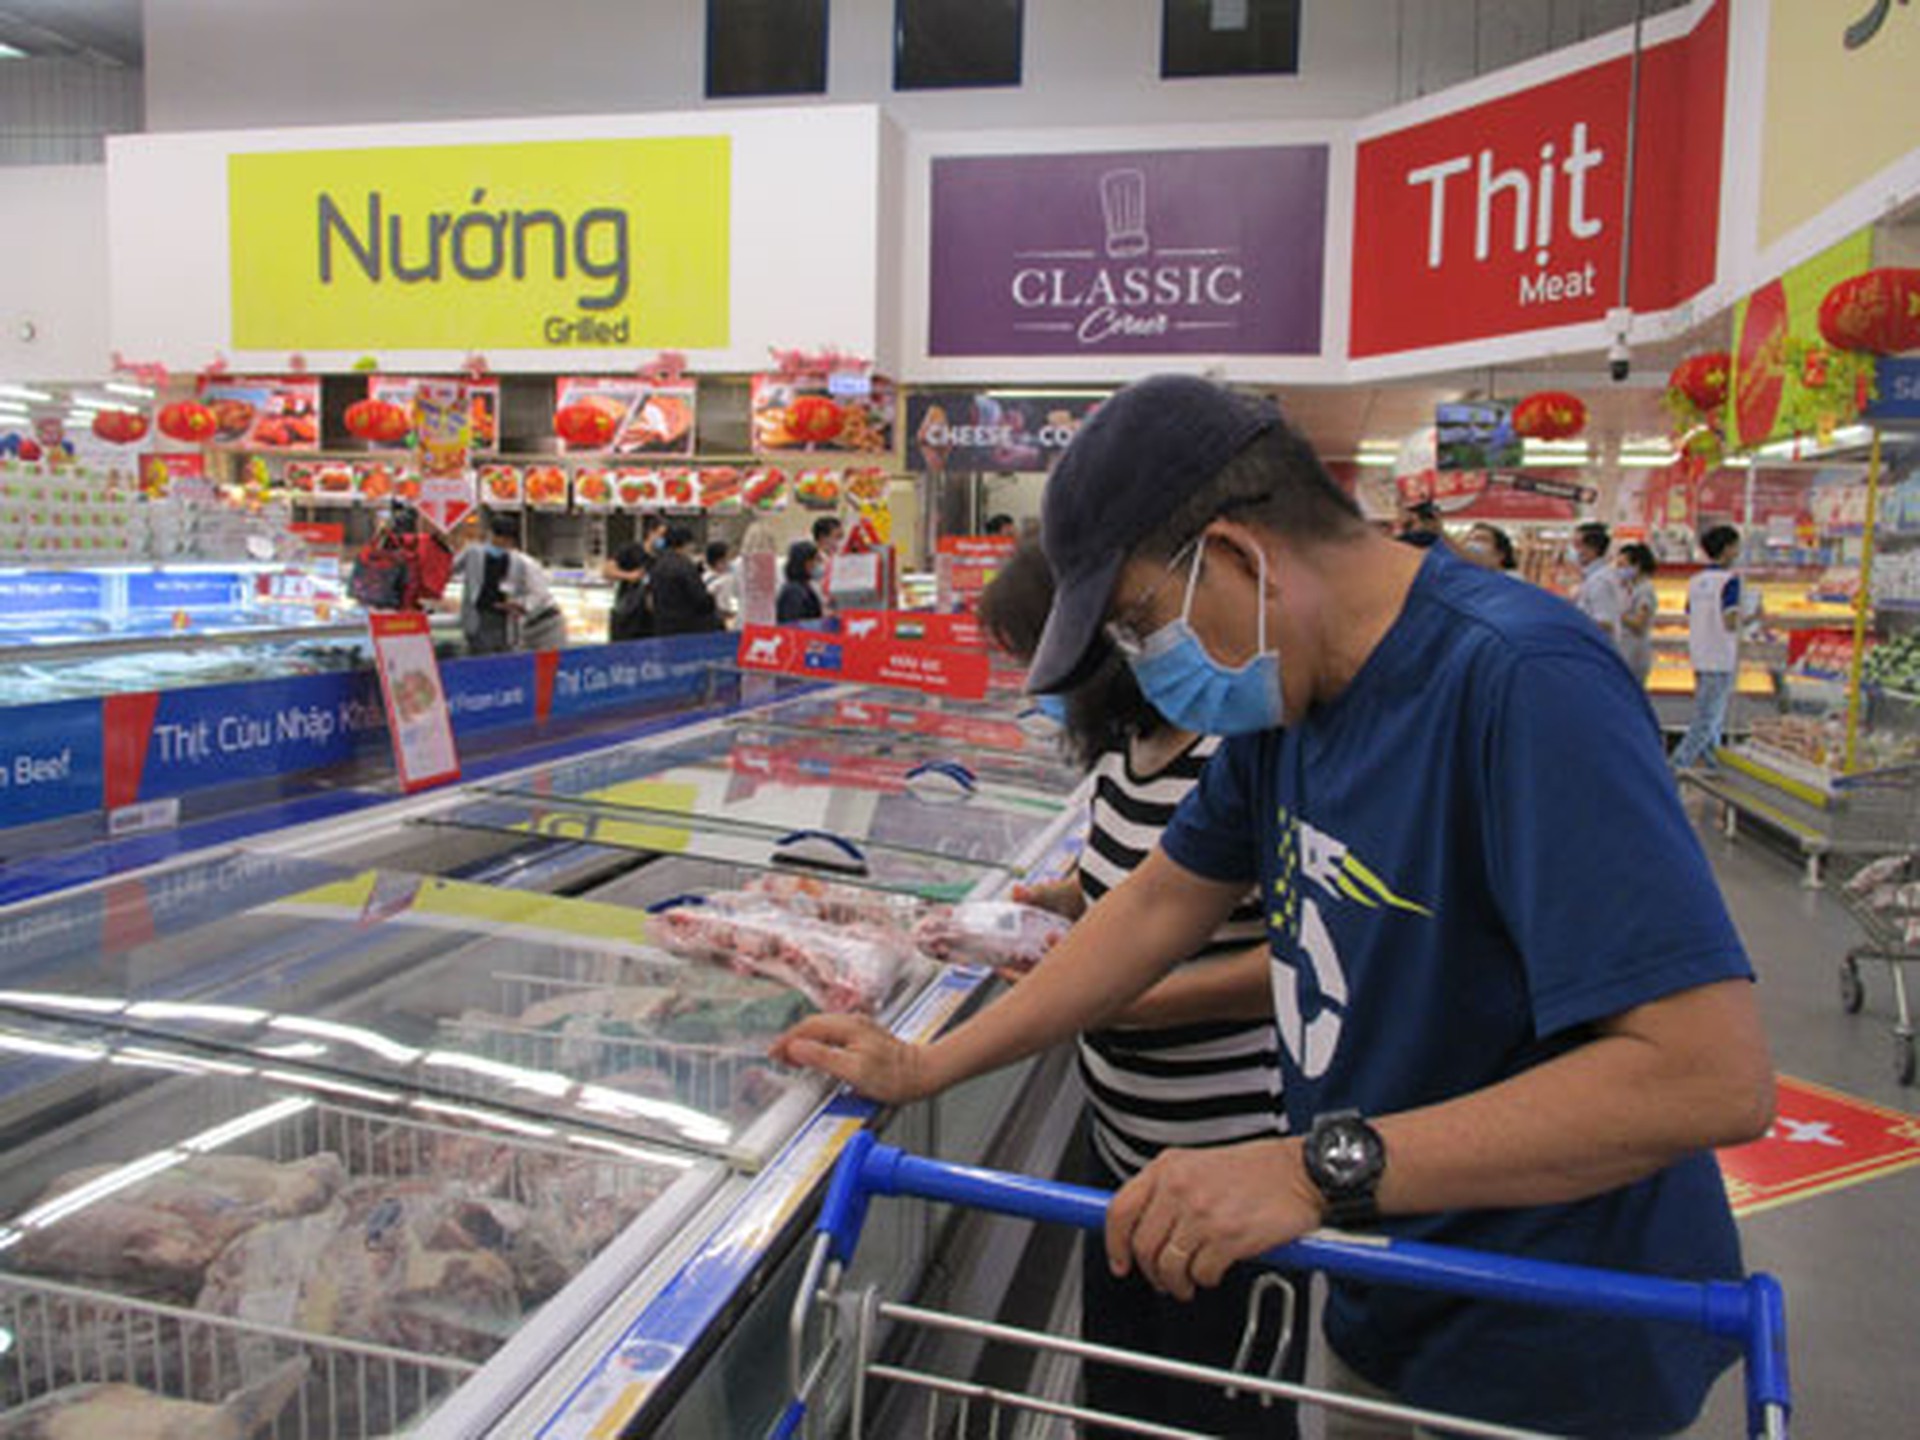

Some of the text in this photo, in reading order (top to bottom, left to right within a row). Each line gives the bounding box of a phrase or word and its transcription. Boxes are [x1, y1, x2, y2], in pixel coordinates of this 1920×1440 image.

[1406, 121, 1604, 269] Thịt
[317, 188, 631, 311] Nướng
[1011, 264, 1243, 307] CLASSIC
[1518, 260, 1597, 306] Meat
[543, 316, 631, 346] Grilled
[1078, 305, 1170, 343] Corner
[925, 424, 1013, 447] CHEESE
[154, 719, 211, 766] Thịt
[217, 712, 271, 753] Cừu
[276, 702, 335, 747] Nhập
[14, 746, 71, 788] Beef
